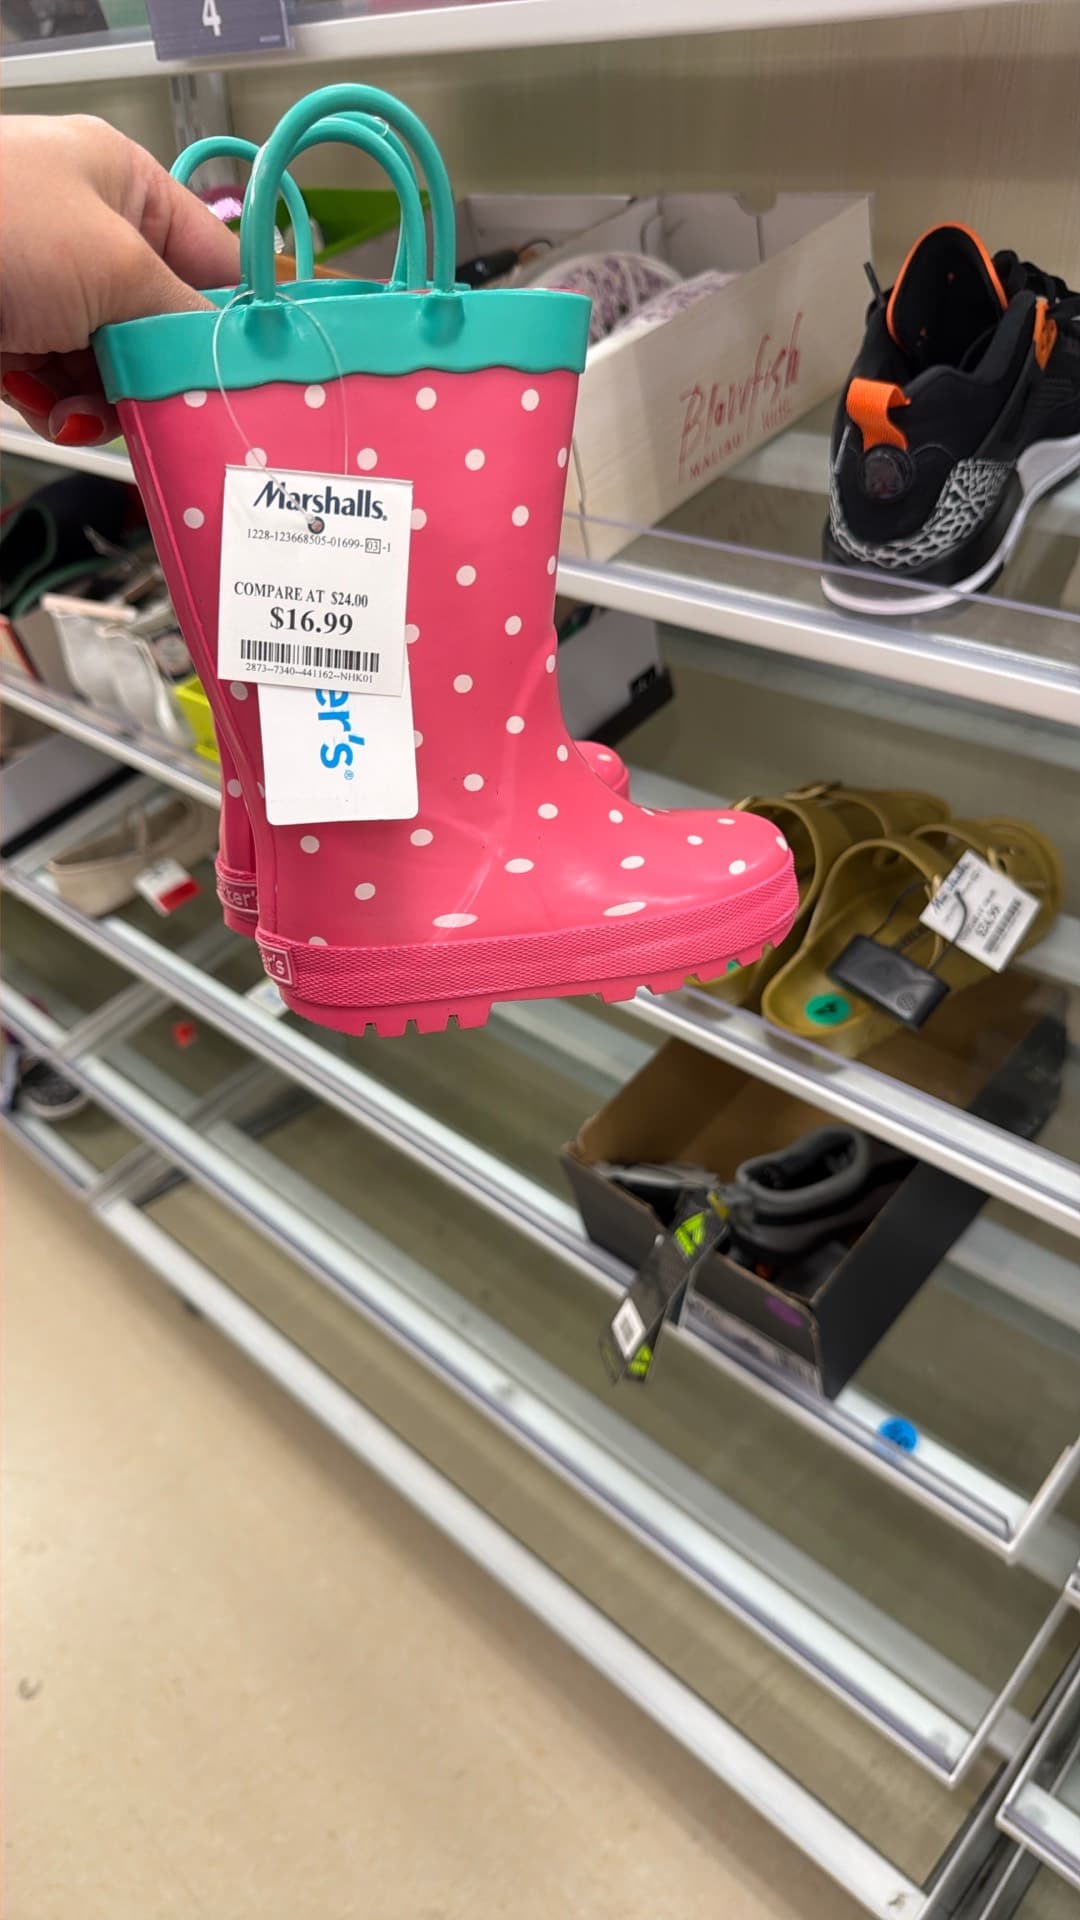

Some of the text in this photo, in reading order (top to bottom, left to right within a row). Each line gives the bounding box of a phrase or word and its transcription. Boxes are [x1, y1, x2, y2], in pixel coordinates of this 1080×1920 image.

[202, 0, 221, 37] 4
[253, 480, 388, 520] Marshalls
[234, 581, 369, 608] COMPARE AT $24.00
[269, 605, 354, 636] $16.99
